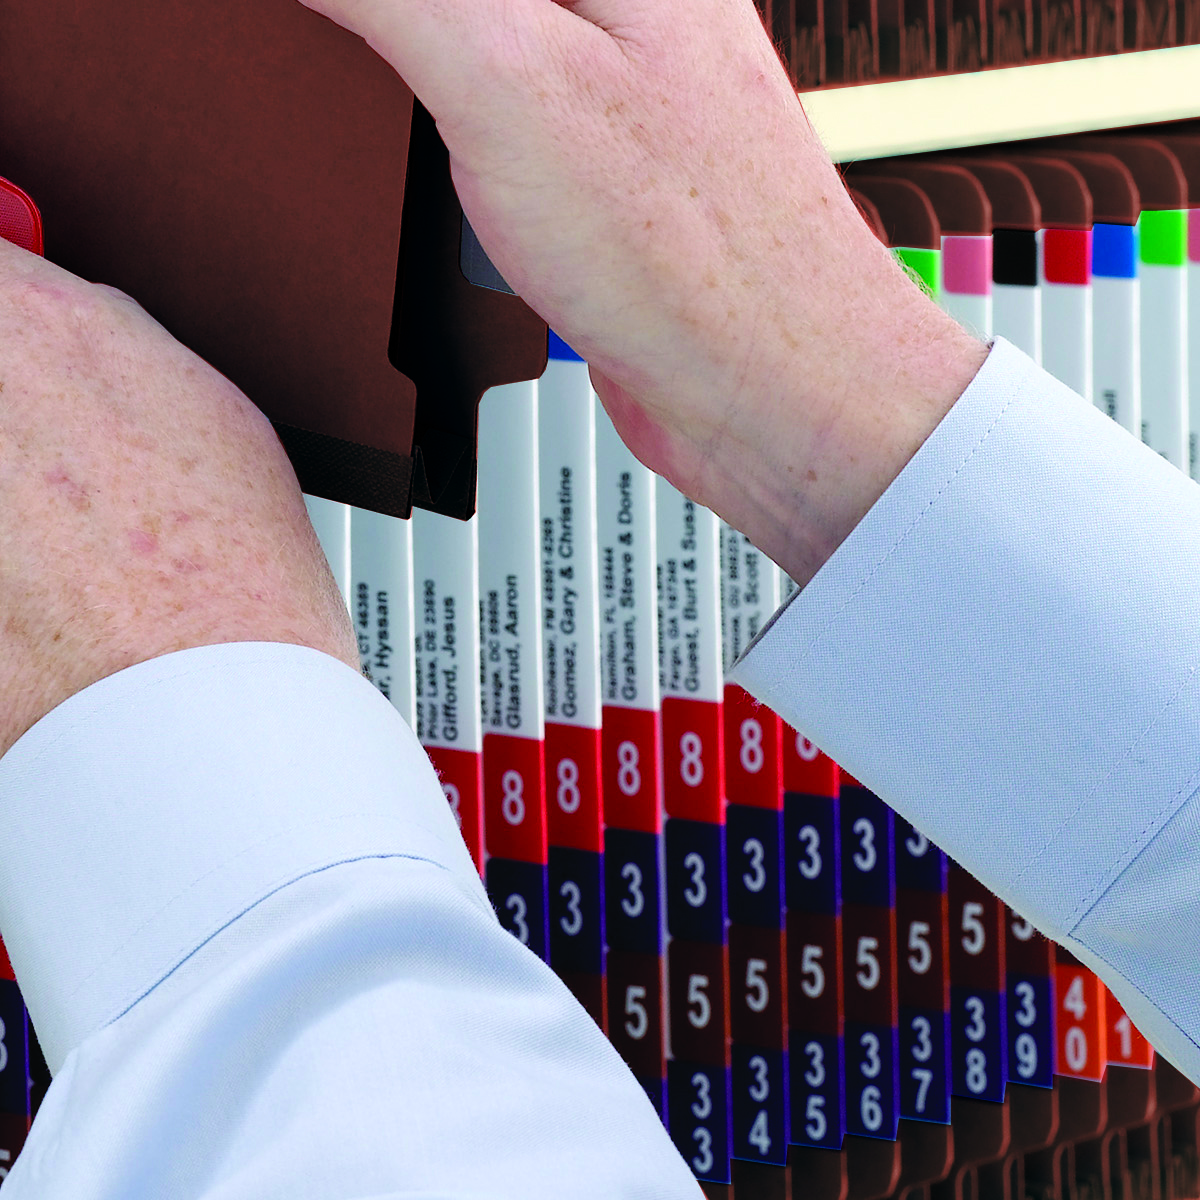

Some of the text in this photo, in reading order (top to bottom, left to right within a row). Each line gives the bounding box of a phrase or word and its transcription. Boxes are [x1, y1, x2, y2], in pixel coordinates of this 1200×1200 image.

[374, 591, 392, 668] Hyssan
[504, 575, 522, 730] Glasrud, Aaron
[558, 467, 577, 718] Gomez, Gary & Christine
[617, 472, 637, 701] Graham, Steve & Doris
[441, 597, 458, 742] Gifford, Jesus
